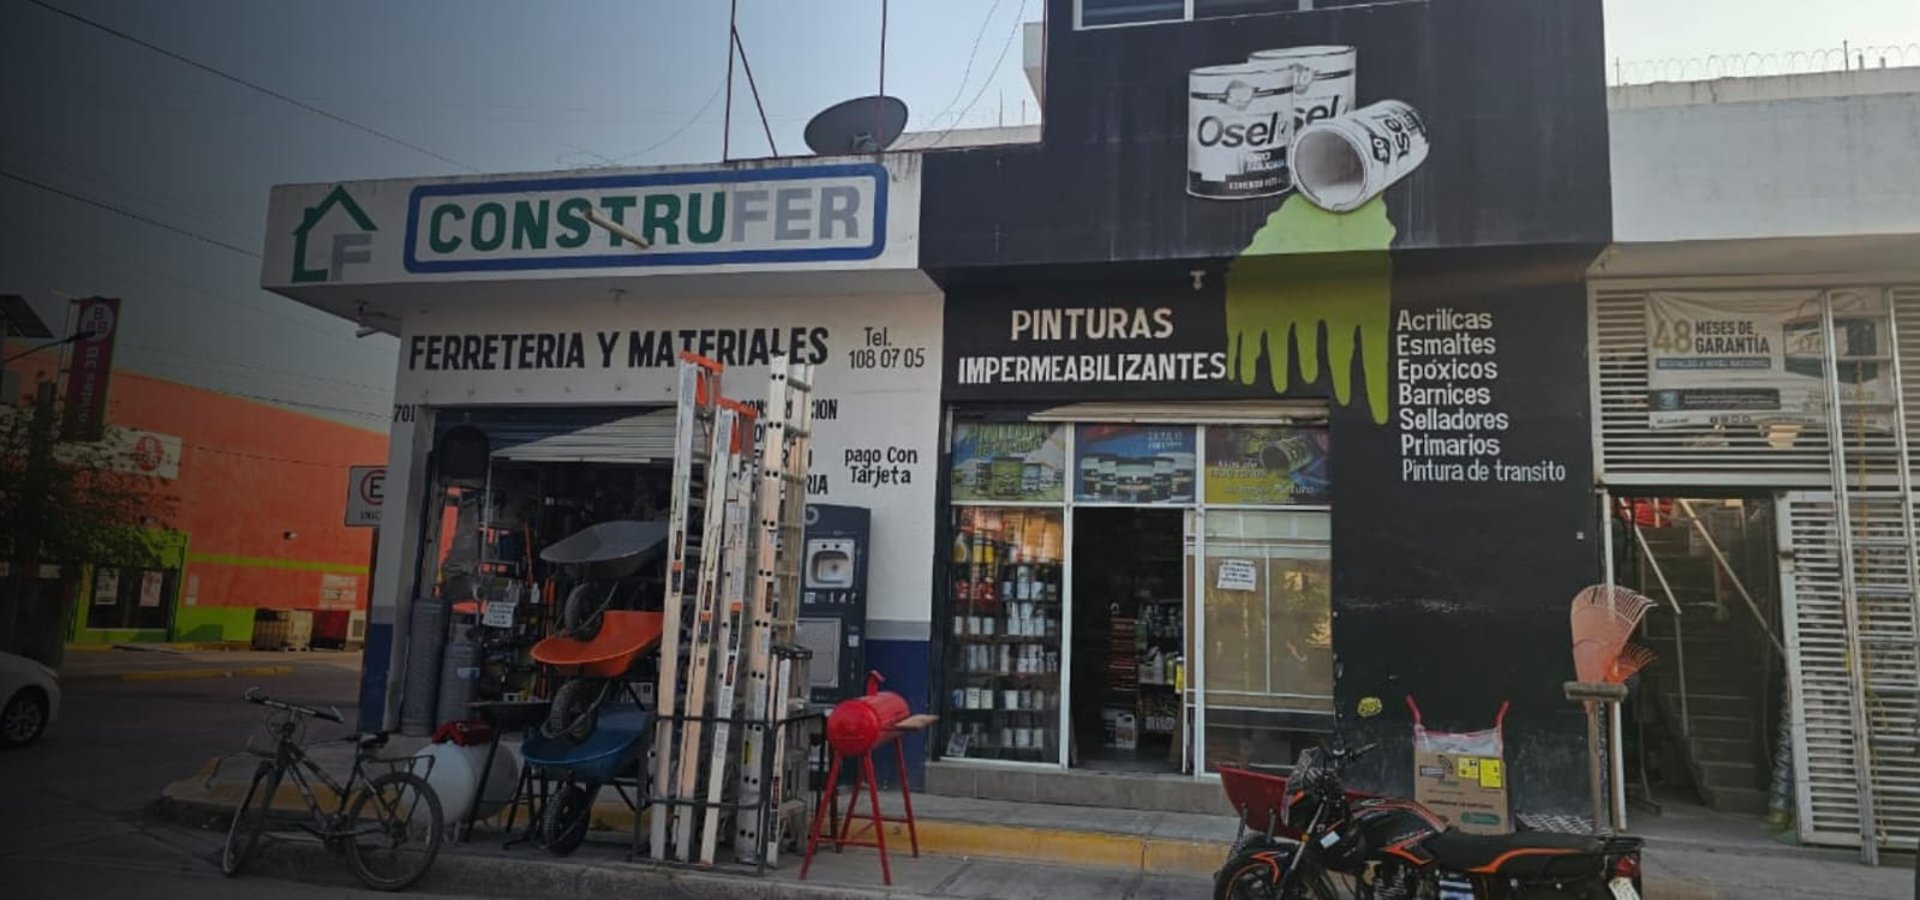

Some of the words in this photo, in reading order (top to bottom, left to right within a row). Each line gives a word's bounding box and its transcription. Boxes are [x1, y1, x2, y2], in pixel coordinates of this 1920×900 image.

[1197, 112, 1278, 148] Osel
[430, 186, 861, 254] CONSTRUFER
[1011, 307, 1174, 341] PINTURAS
[1653, 318, 1692, 354] 48
[1695, 320, 1736, 336] MESES
[1738, 320, 1754, 334] DE
[864, 326, 892, 347] Tel.
[1397, 332, 1497, 356] Esmaltes
[1695, 333, 1771, 355] GARANTÍA
[409, 332, 586, 371] FERRETERIA
[597, 331, 620, 368] Y
[849, 350, 877, 370] 108
[880, 349, 900, 368] 07
[903, 347, 926, 369] 05
[958, 352, 1227, 384] IMPERMEABILIZANTES
[1399, 382, 1491, 406] Barnices
[393, 404, 415, 423] 701
[1399, 407, 1510, 431] Selladores
[1401, 433, 1502, 456] Primarios
[844, 450, 882, 469] pago
[886, 446, 918, 464] Con
[1403, 458, 1464, 481] Pintura
[1467, 457, 1489, 481] de
[1493, 458, 1567, 481] transito
[851, 466, 912, 489] Tarjeta
